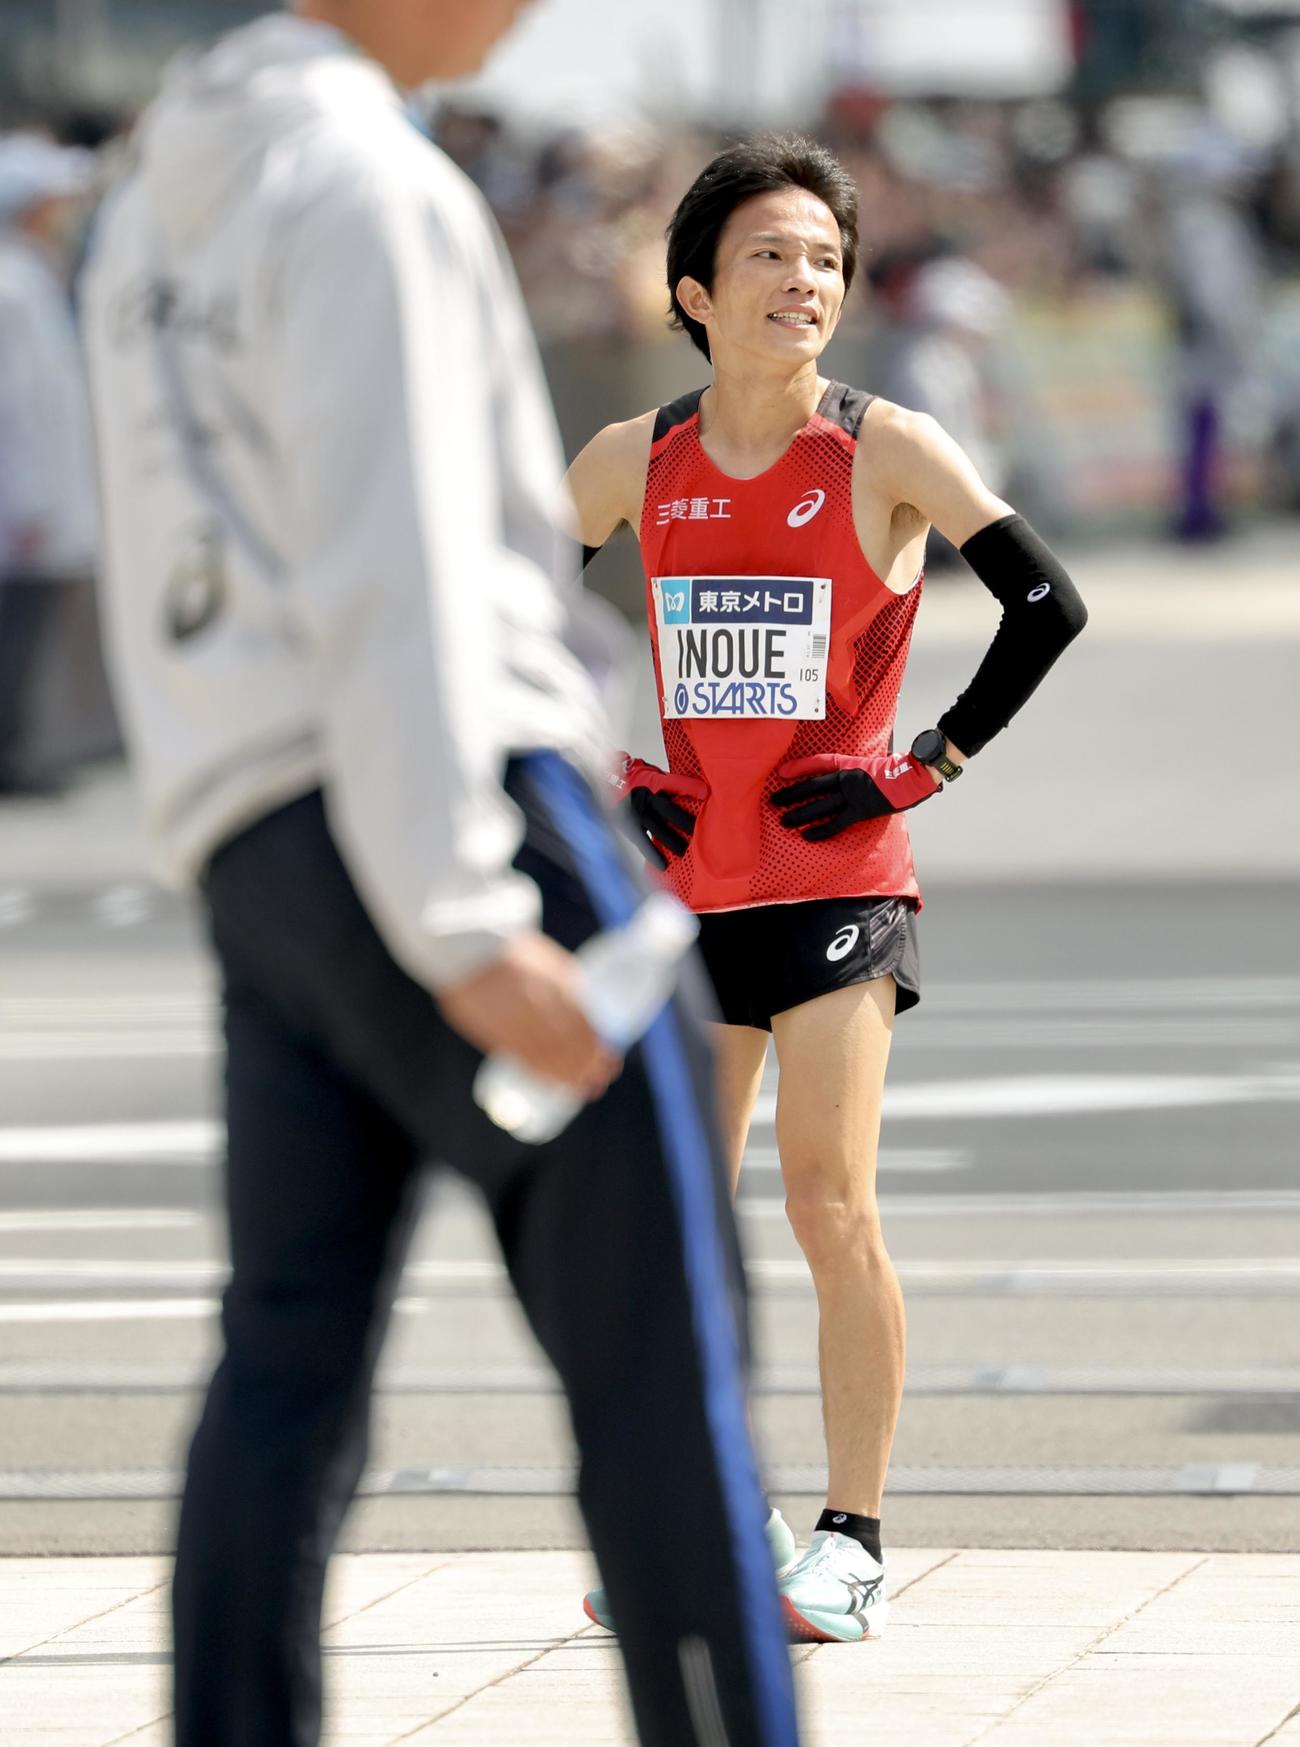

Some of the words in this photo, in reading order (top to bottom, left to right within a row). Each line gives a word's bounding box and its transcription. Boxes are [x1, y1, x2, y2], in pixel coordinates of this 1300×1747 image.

[656, 497, 731, 525] 三菱重工
[698, 590, 804, 613] 東京メトロ
[677, 629, 787, 679] INOUE
[799, 668, 819, 682] 105
